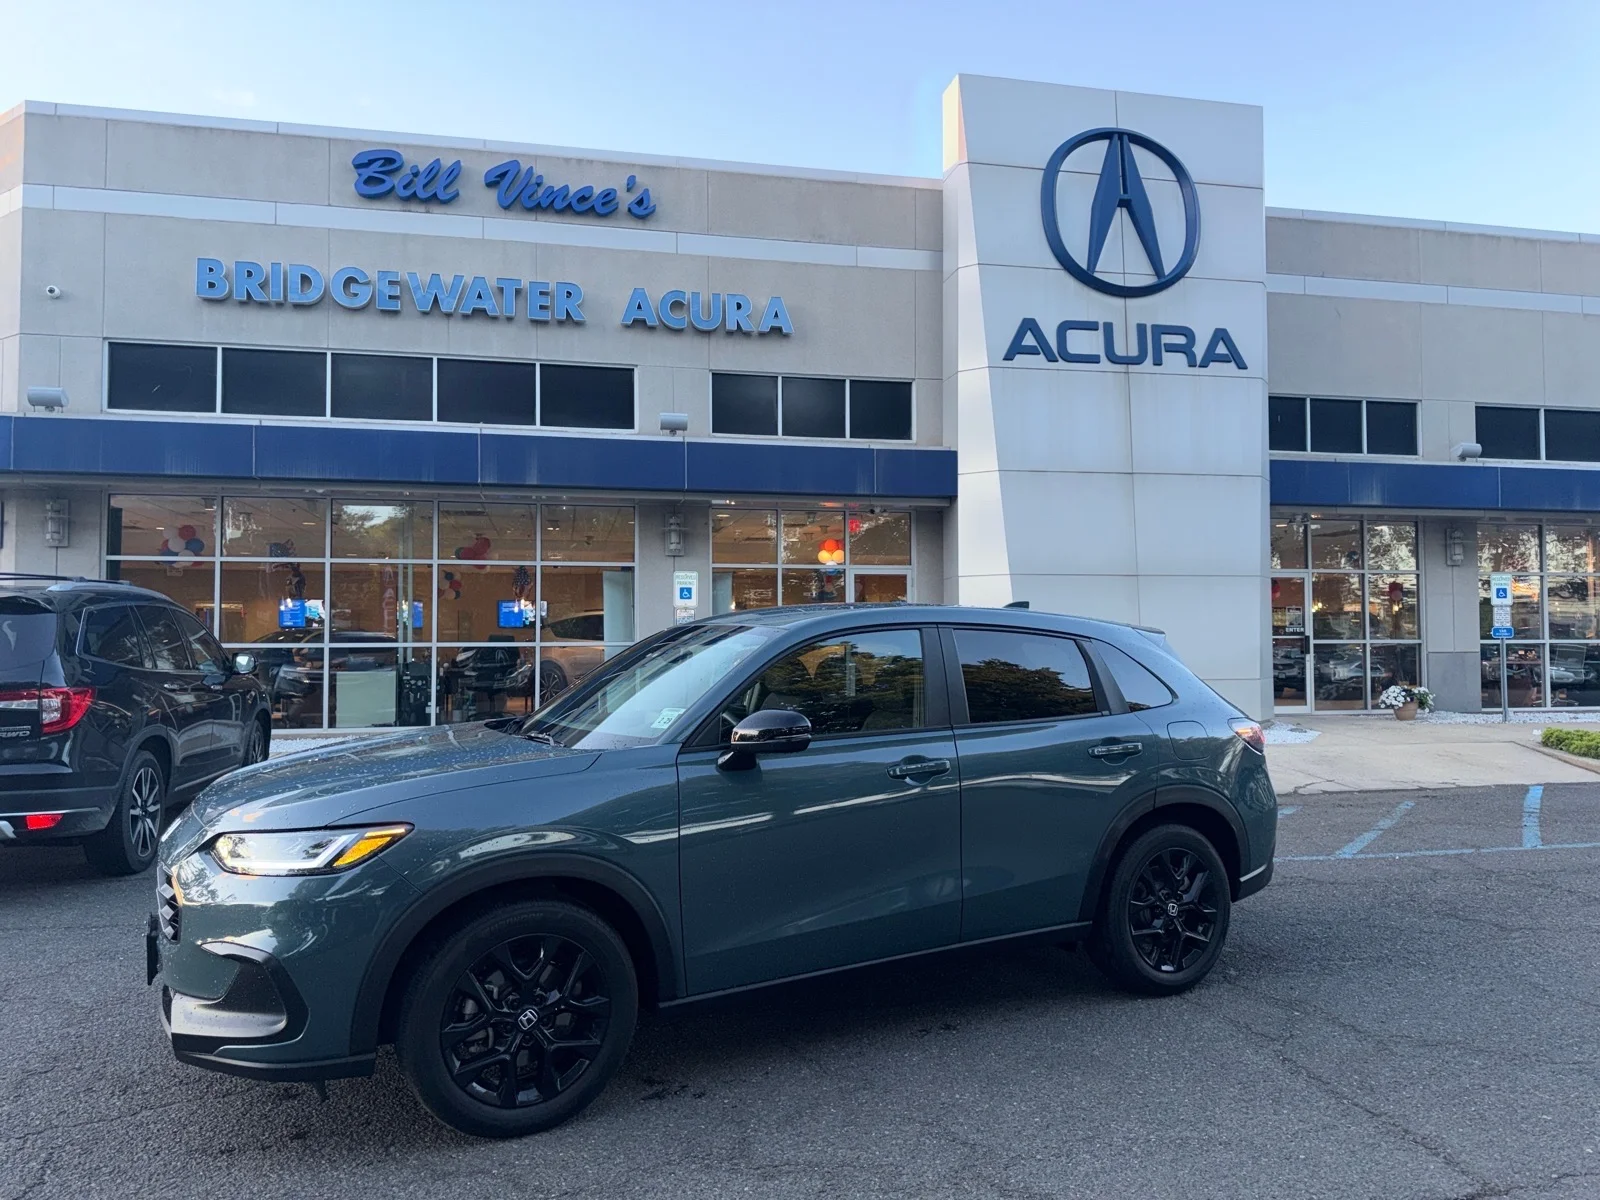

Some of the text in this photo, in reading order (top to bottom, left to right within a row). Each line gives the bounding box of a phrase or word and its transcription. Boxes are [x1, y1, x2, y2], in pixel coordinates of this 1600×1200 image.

[351, 148, 657, 219] Bill Vince's
[195, 256, 795, 336] BRIDGEWATER ACURA
[1002, 317, 1249, 370] ACURA
